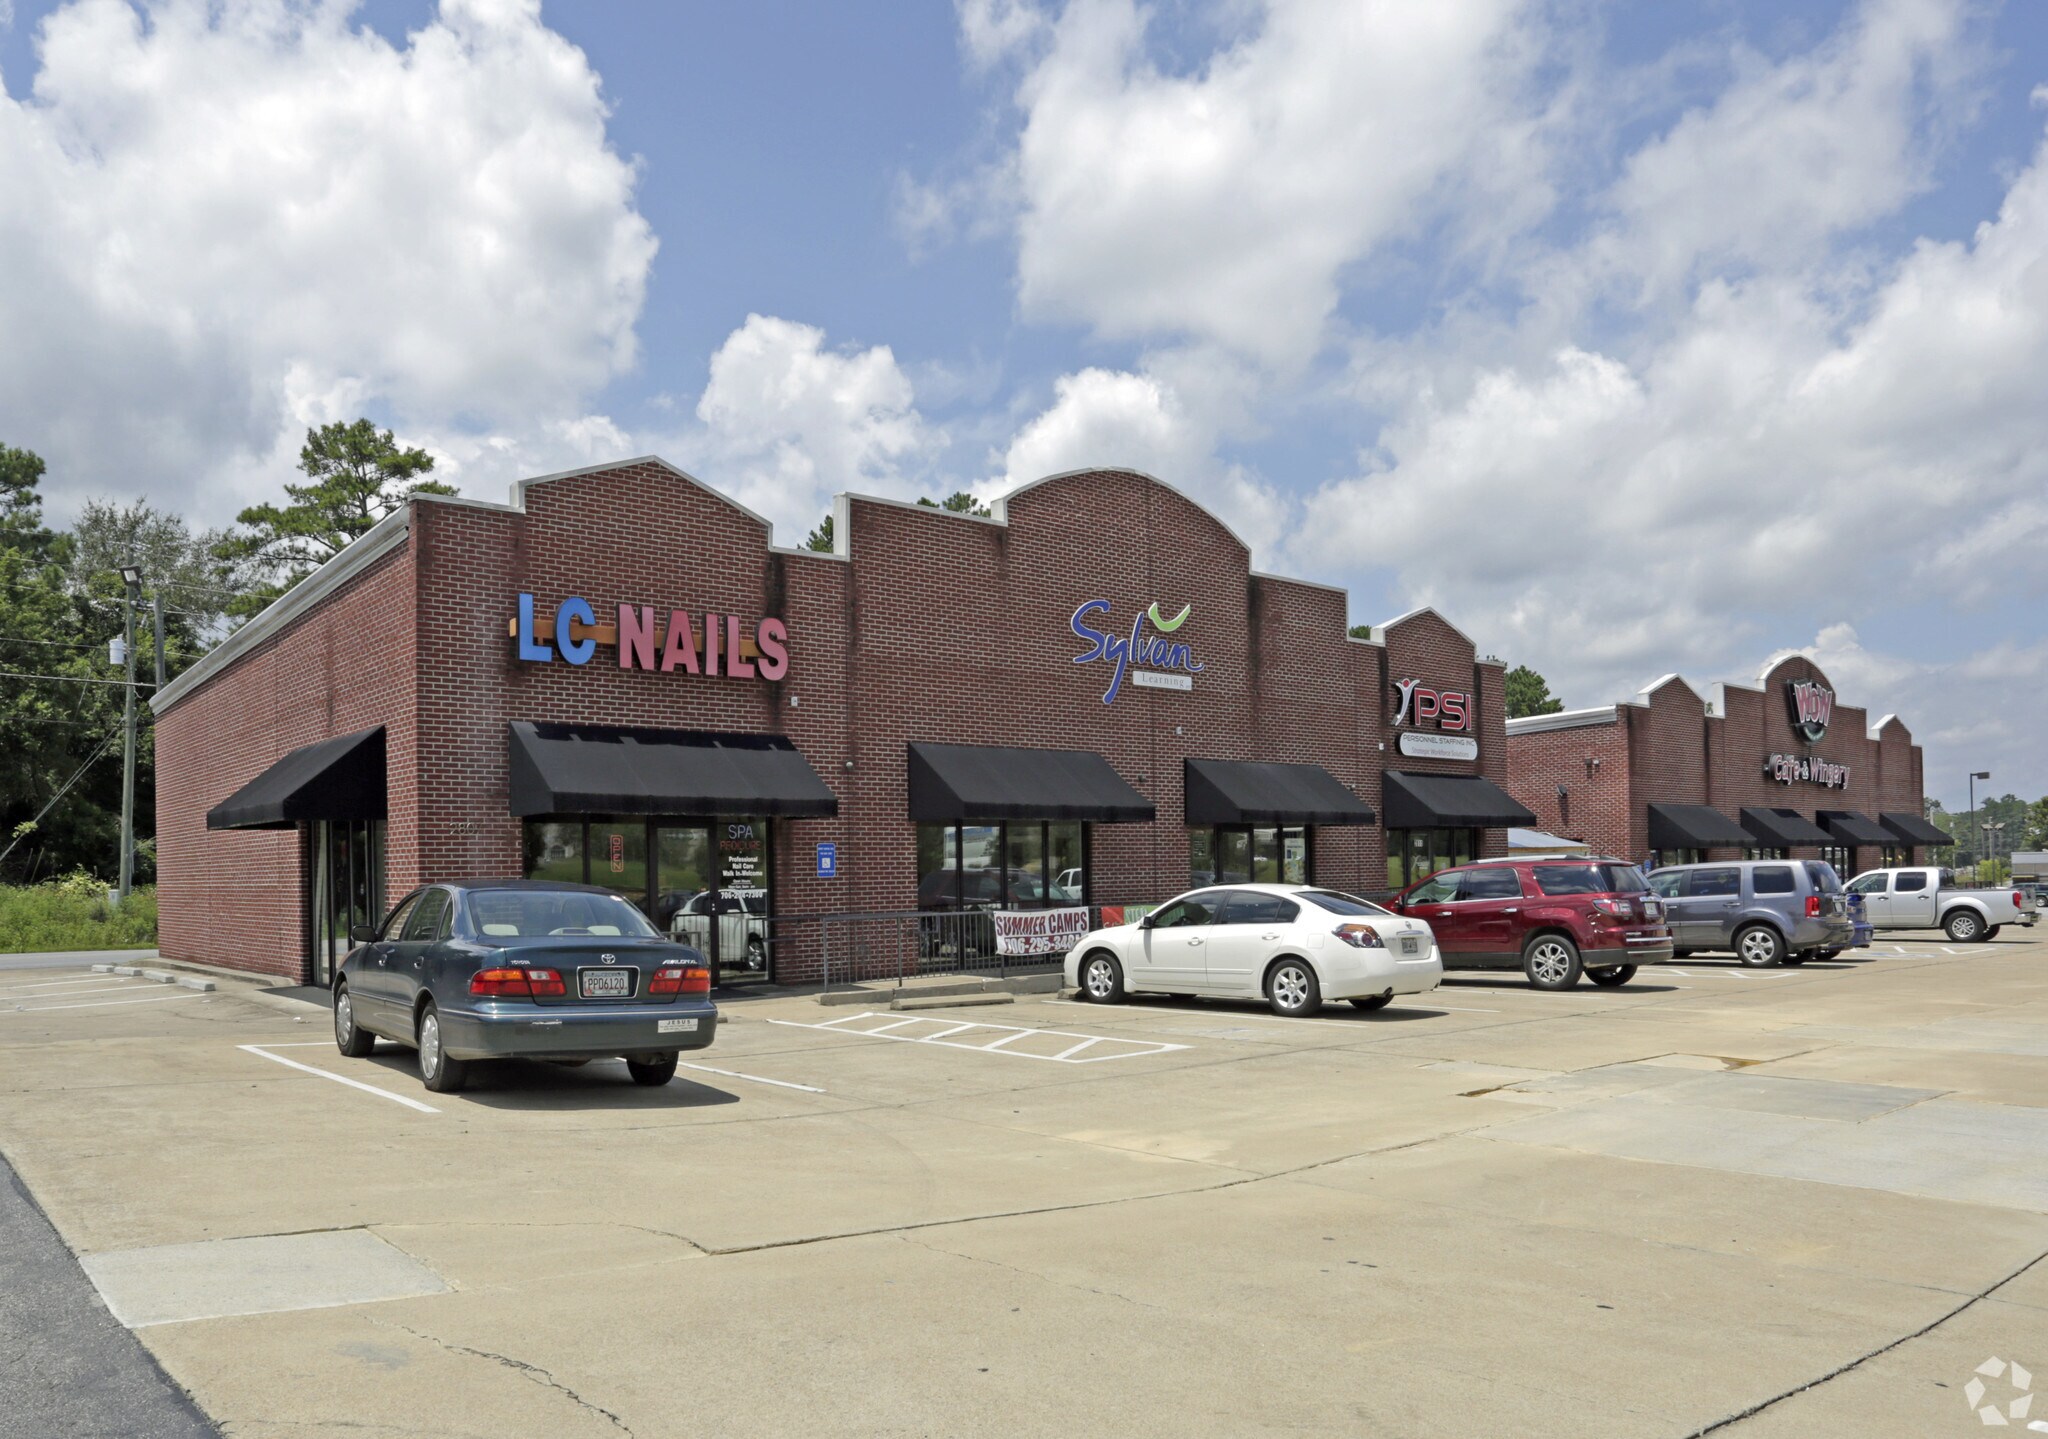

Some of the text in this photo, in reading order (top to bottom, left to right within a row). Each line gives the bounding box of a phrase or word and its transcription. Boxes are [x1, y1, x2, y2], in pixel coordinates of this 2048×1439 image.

[518, 593, 788, 681] LC NAILS
[1071, 599, 1205, 705] Sylvan
[1142, 672, 1185, 689] Learning
[1414, 688, 1471, 730] PSI
[1794, 682, 1832, 727] WOW
[1403, 734, 1438, 744] PERSONNEL
[1439, 737, 1465, 746] STAFFING
[1809, 757, 1851, 790] Wingery
[728, 825, 753, 839] SPA
[612, 837, 621, 870] OPEN
[996, 911, 1087, 937] SUMMER CAMPS
[587, 977, 625, 990] PPD6120
